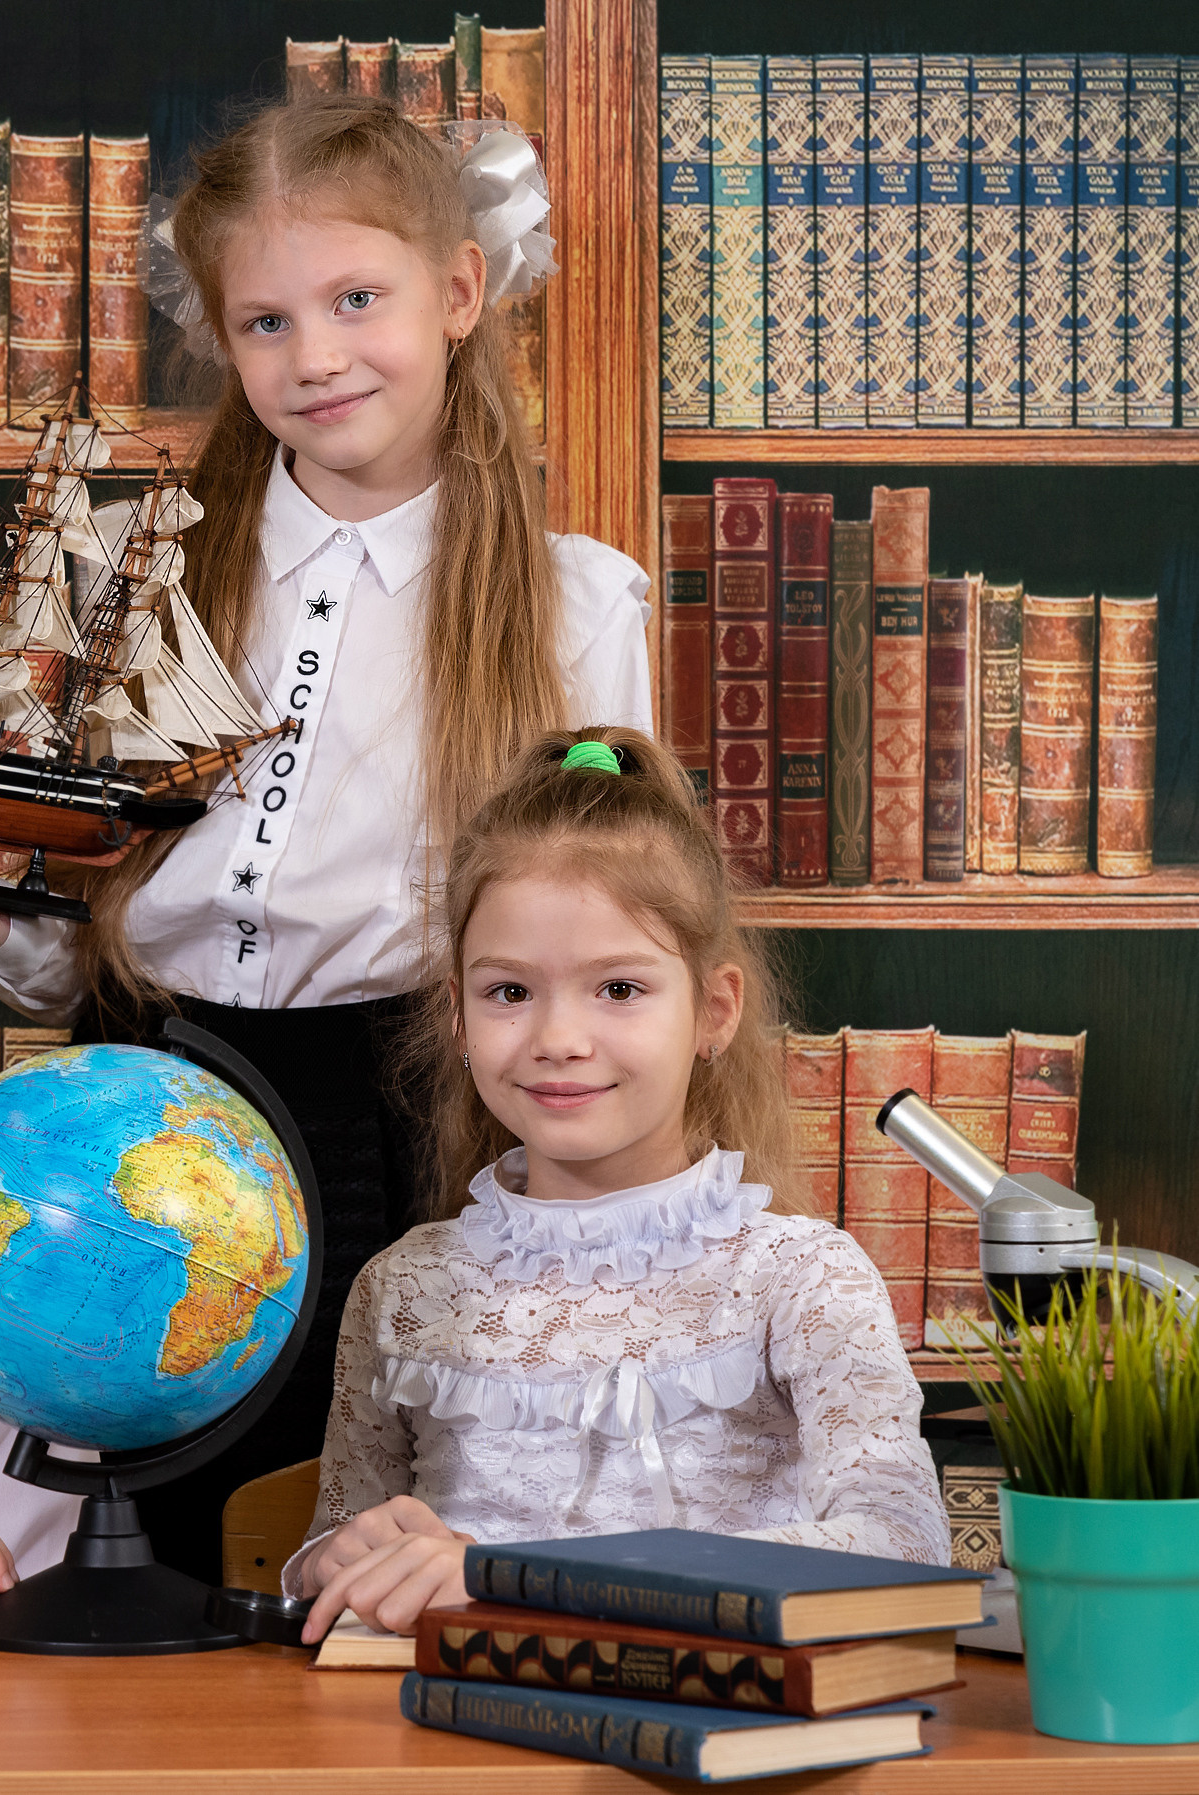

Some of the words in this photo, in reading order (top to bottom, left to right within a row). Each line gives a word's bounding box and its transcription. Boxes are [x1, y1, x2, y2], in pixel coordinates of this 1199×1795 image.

[795, 591, 815, 601] LEO
[785, 602, 824, 614] TOLSTOY
[881, 615, 898, 627] BEN
[900, 616, 918, 627] HUR
[787, 763, 818, 776] ANNA
[782, 776, 822, 788] KARENIN
[236, 919, 258, 964] OF
[81, 1253, 128, 1277] ОКЕАН
[621, 1671, 672, 1691] КУПЕР
